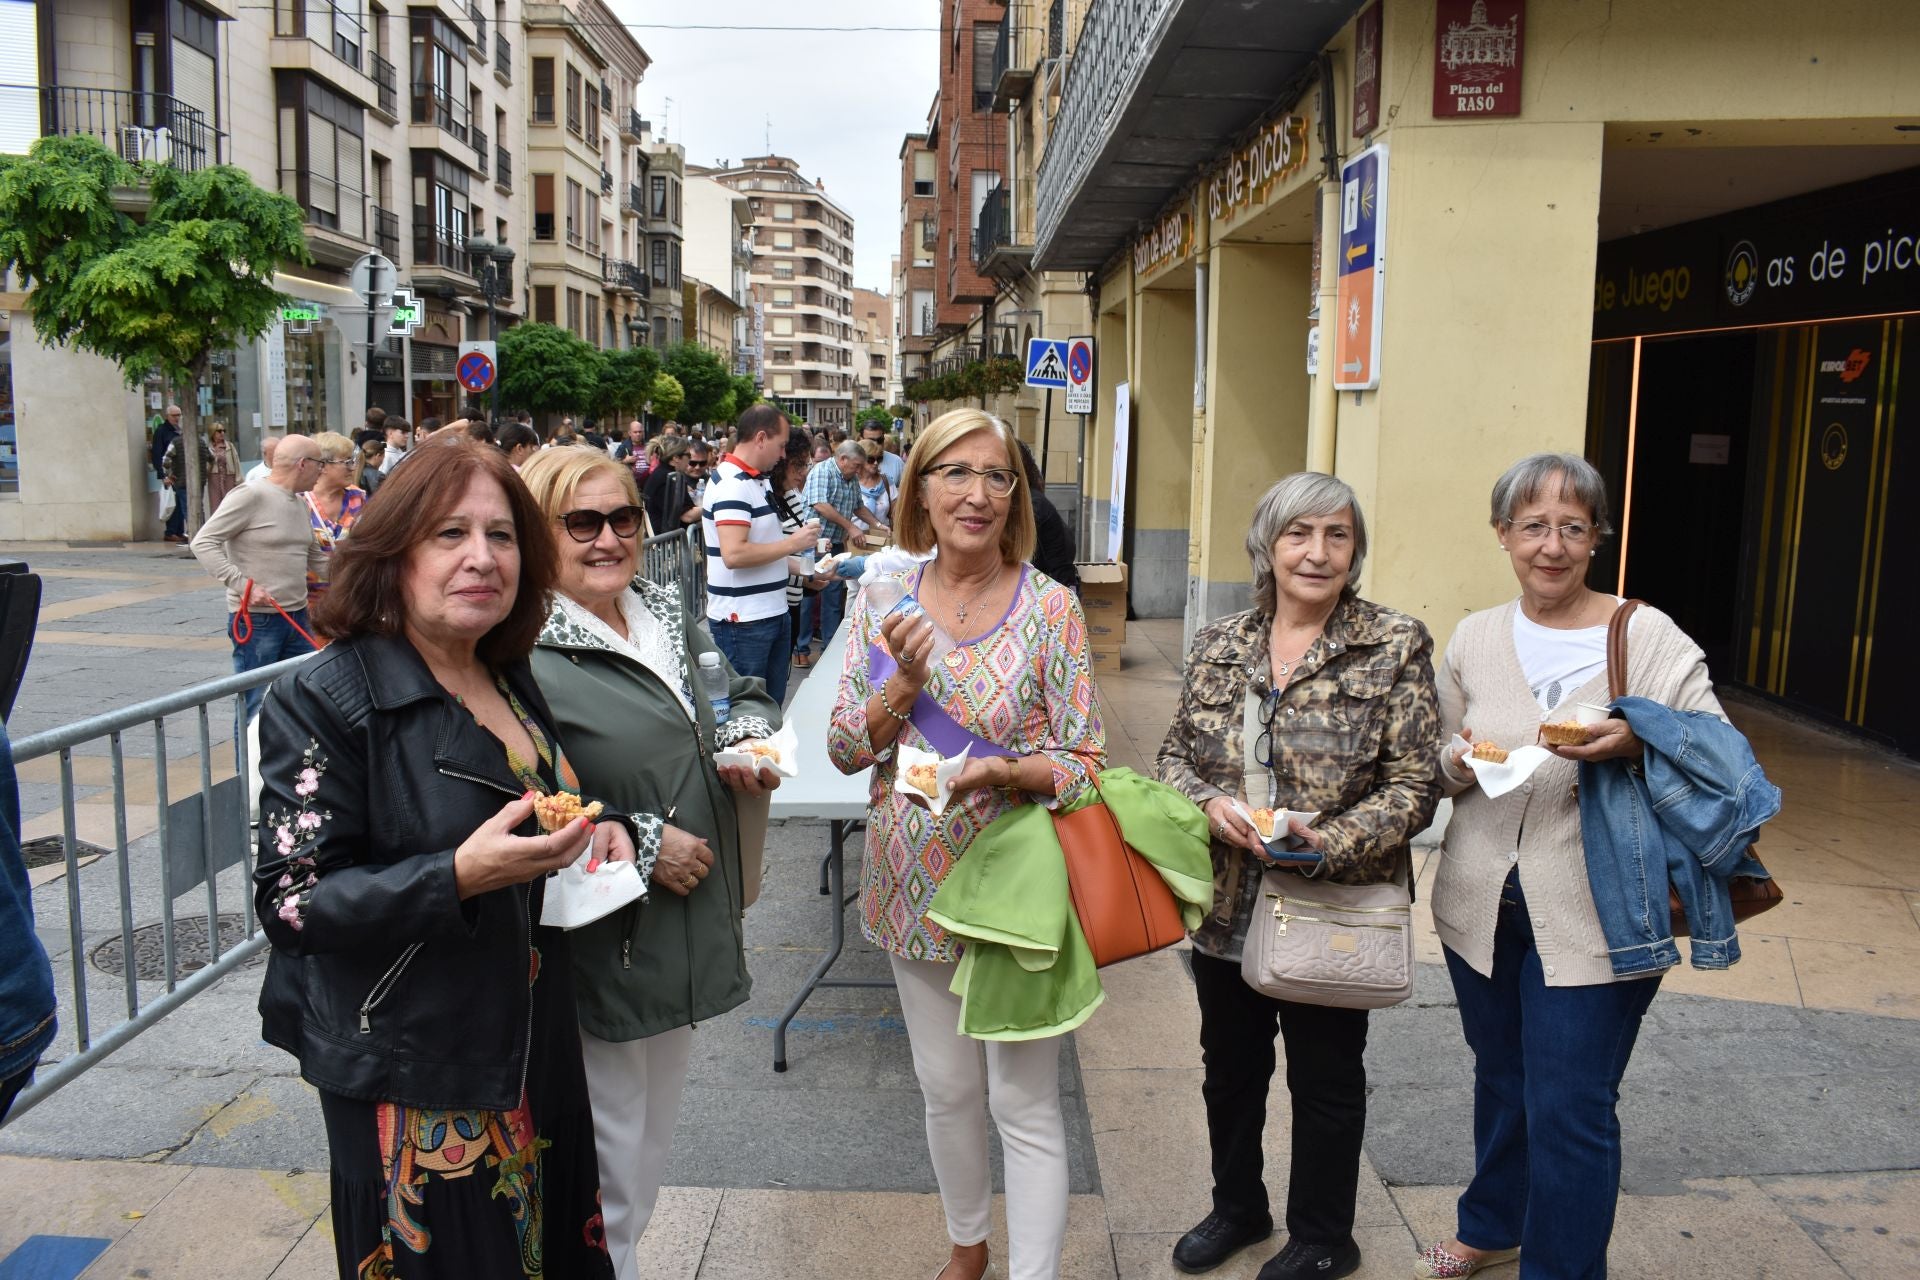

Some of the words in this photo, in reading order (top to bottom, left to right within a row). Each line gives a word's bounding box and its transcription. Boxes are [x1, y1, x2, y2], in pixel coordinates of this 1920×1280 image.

[1449, 84, 1482, 95] Plaza
[1486, 82, 1504, 94] del
[1457, 96, 1495, 112] RASO
[1209, 179, 1221, 221] as
[1226, 152, 1243, 208] de
[1249, 115, 1291, 205] picas
[1767, 256, 1795, 287] as
[1809, 240, 1846, 281] de
[1622, 266, 1691, 312] Juego
